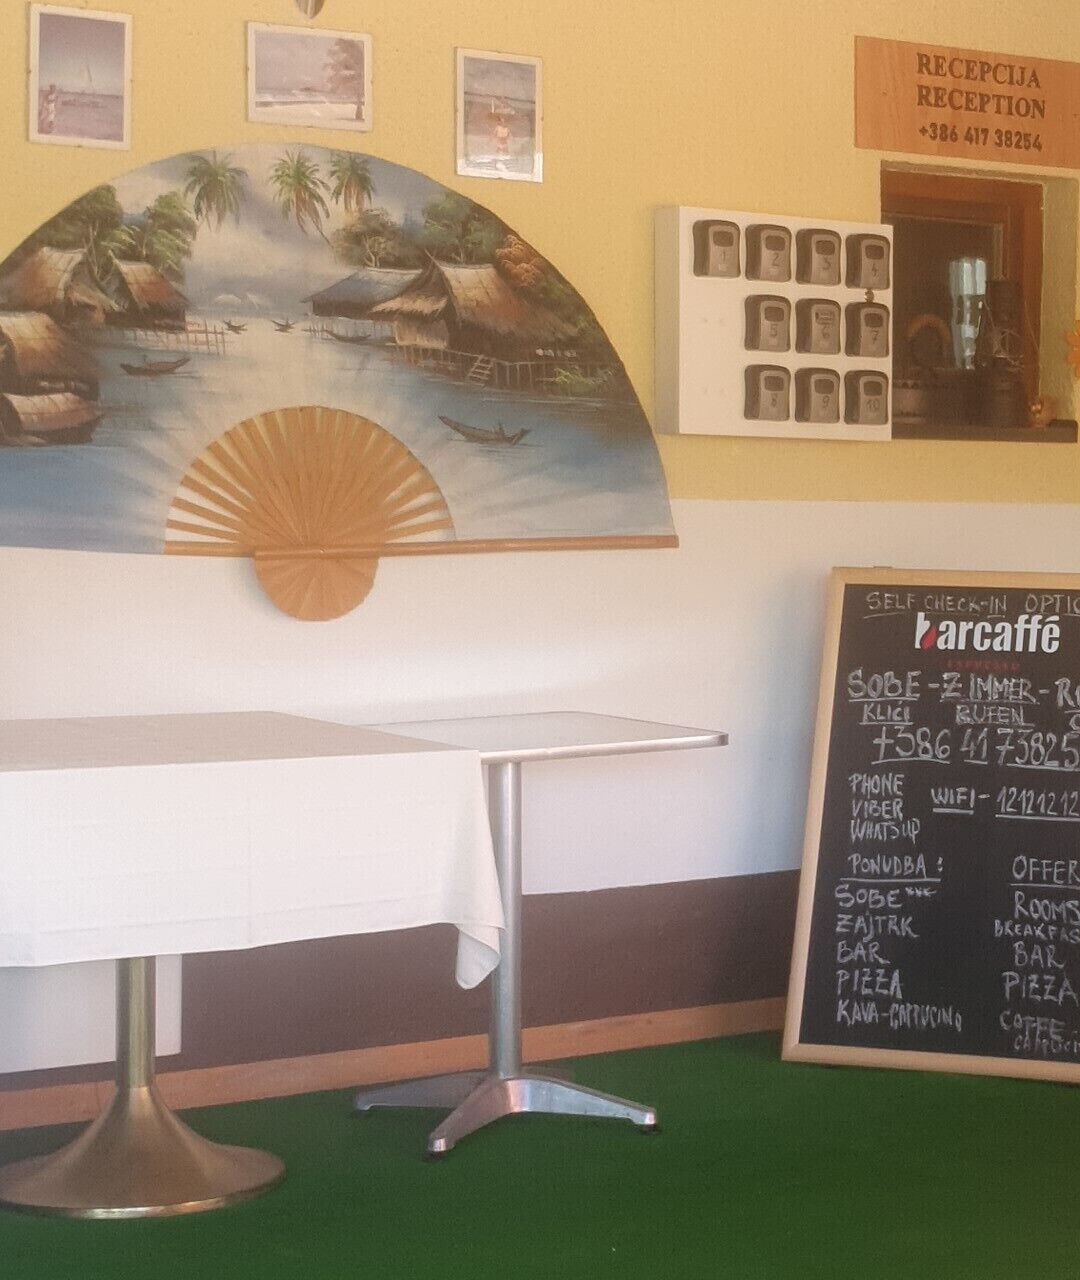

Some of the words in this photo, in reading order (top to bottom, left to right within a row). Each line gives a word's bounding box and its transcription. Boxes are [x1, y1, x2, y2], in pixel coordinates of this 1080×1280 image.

[916, 51, 1041, 89] RECEPCIJA
[916, 84, 1046, 120] RECEPTION
[918, 123, 959, 143] +386
[964, 126, 989, 147] 417
[994, 128, 1043, 153] 38254
[771, 252, 781, 267] 2
[822, 255, 832, 271] 3
[769, 324, 778, 337] 5
[866, 591, 915, 610] SELF
[914, 611, 1060, 654] barcaffé
[847, 668, 922, 699] SOBE
[872, 725, 950, 762] +386
[960, 728, 989, 760] 41
[849, 773, 905, 797] PHONE
[851, 799, 904, 820] VIBER
[835, 910, 920, 942] ZAJTRK
[837, 940, 891, 964] BAR
[1014, 940, 1065, 969] BAR
[836, 968, 903, 999] PIZZA
[1002, 970, 1080, 1007] PIZZA
